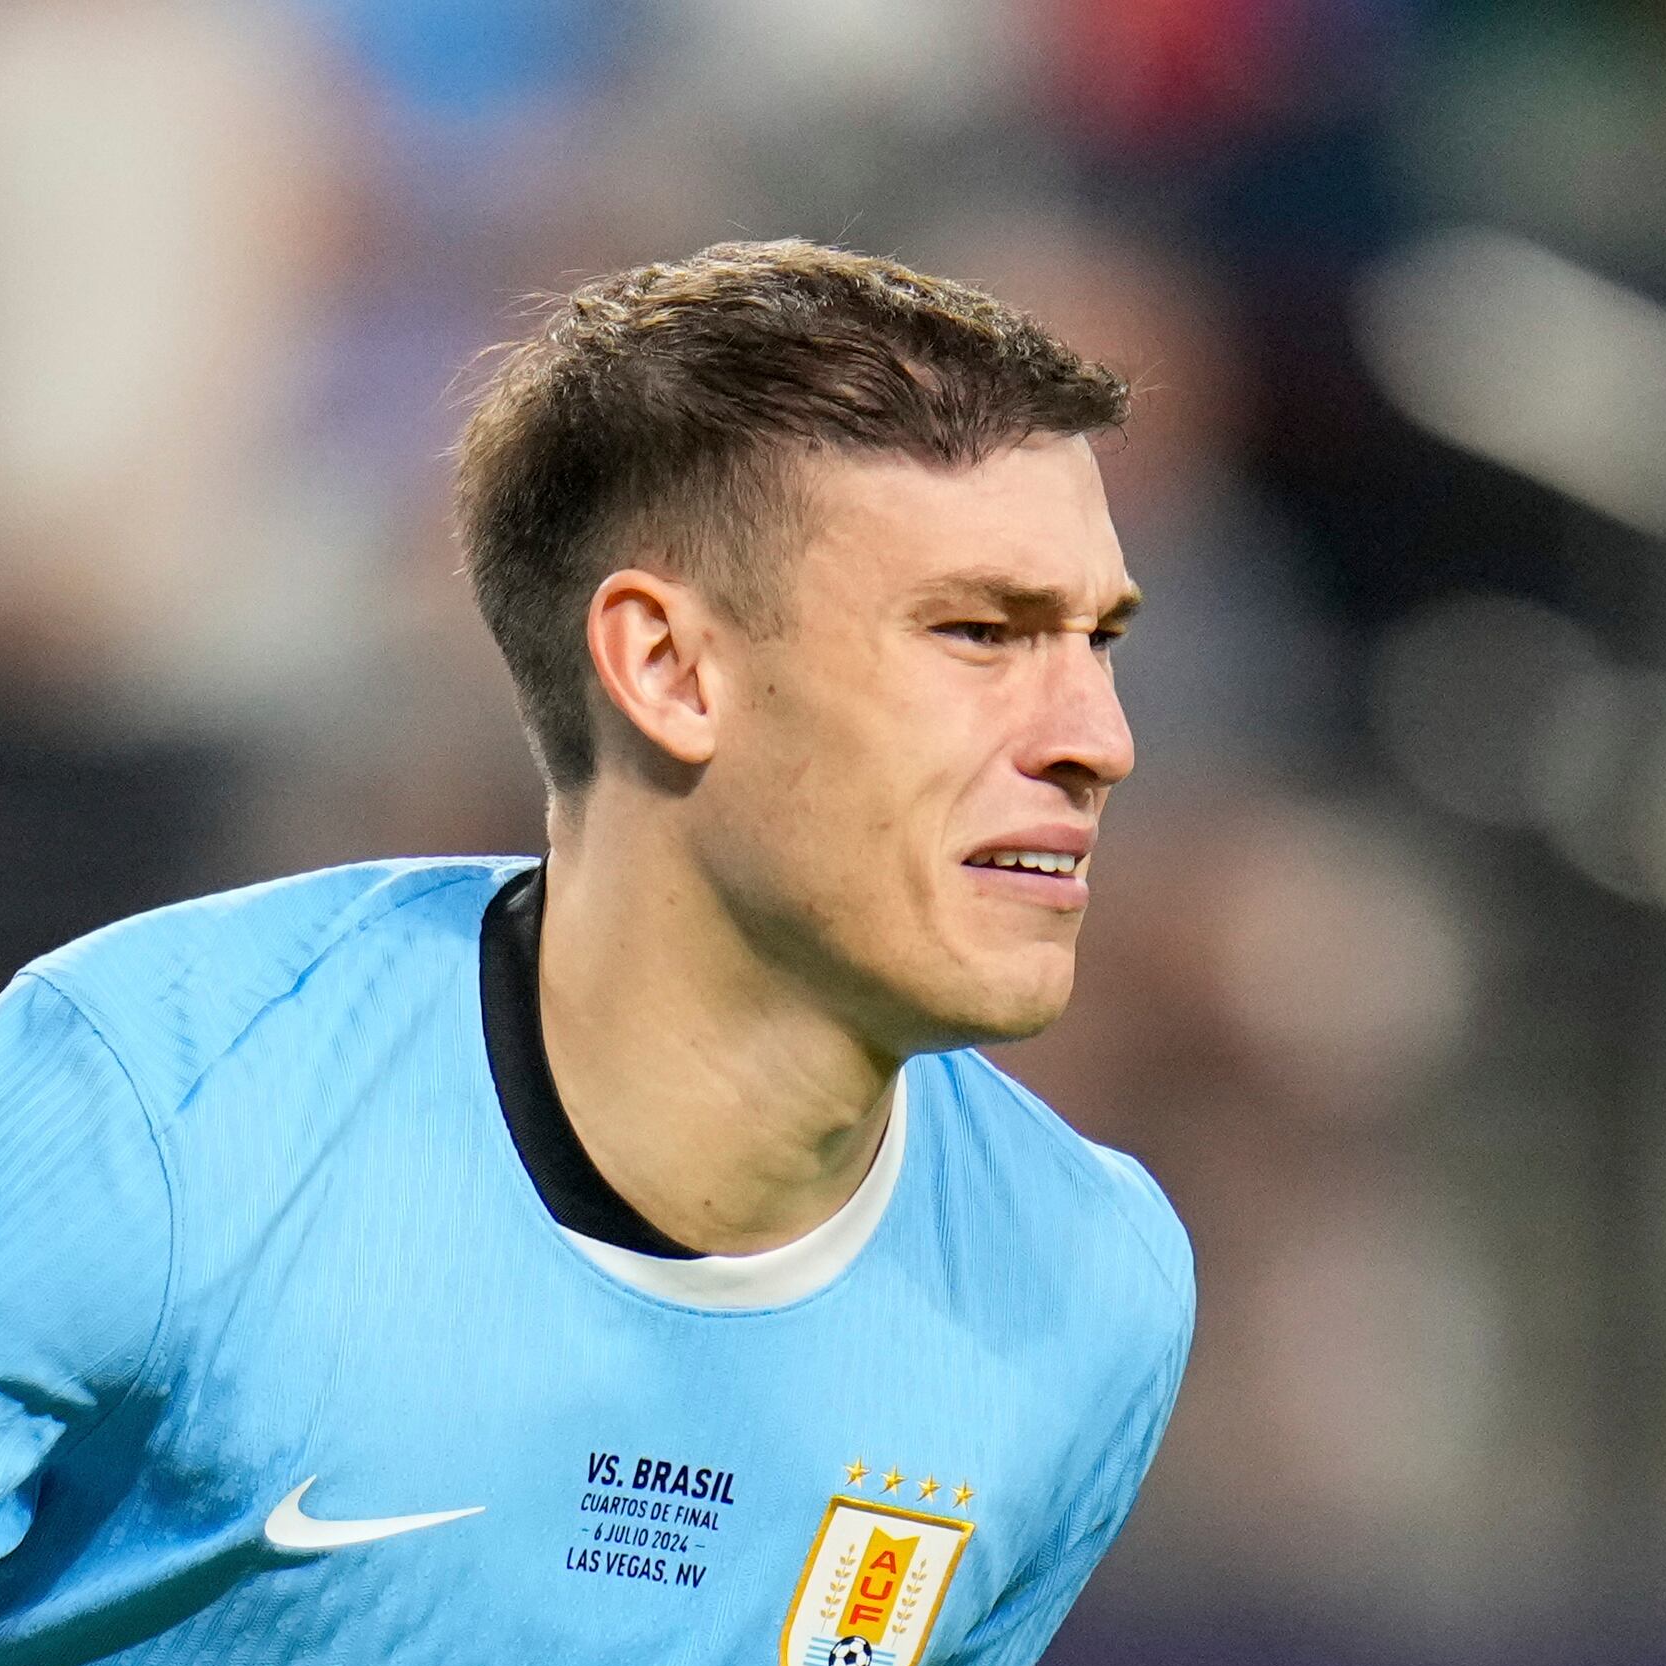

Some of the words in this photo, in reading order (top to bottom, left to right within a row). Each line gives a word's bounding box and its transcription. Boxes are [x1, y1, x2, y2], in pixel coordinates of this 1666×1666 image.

[587, 1451, 624, 1488] VS.
[632, 1457, 735, 1505] BRASIL
[580, 1492, 649, 1519] CUARTOS
[650, 1501, 673, 1523] DE
[674, 1505, 719, 1531] FINAL
[593, 1522, 604, 1541] 6
[604, 1524, 649, 1547] JULIO
[651, 1530, 689, 1553] 2024
[566, 1546, 601, 1573] LAS
[675, 1562, 707, 1588] NV
[848, 1550, 897, 1626] AUF
